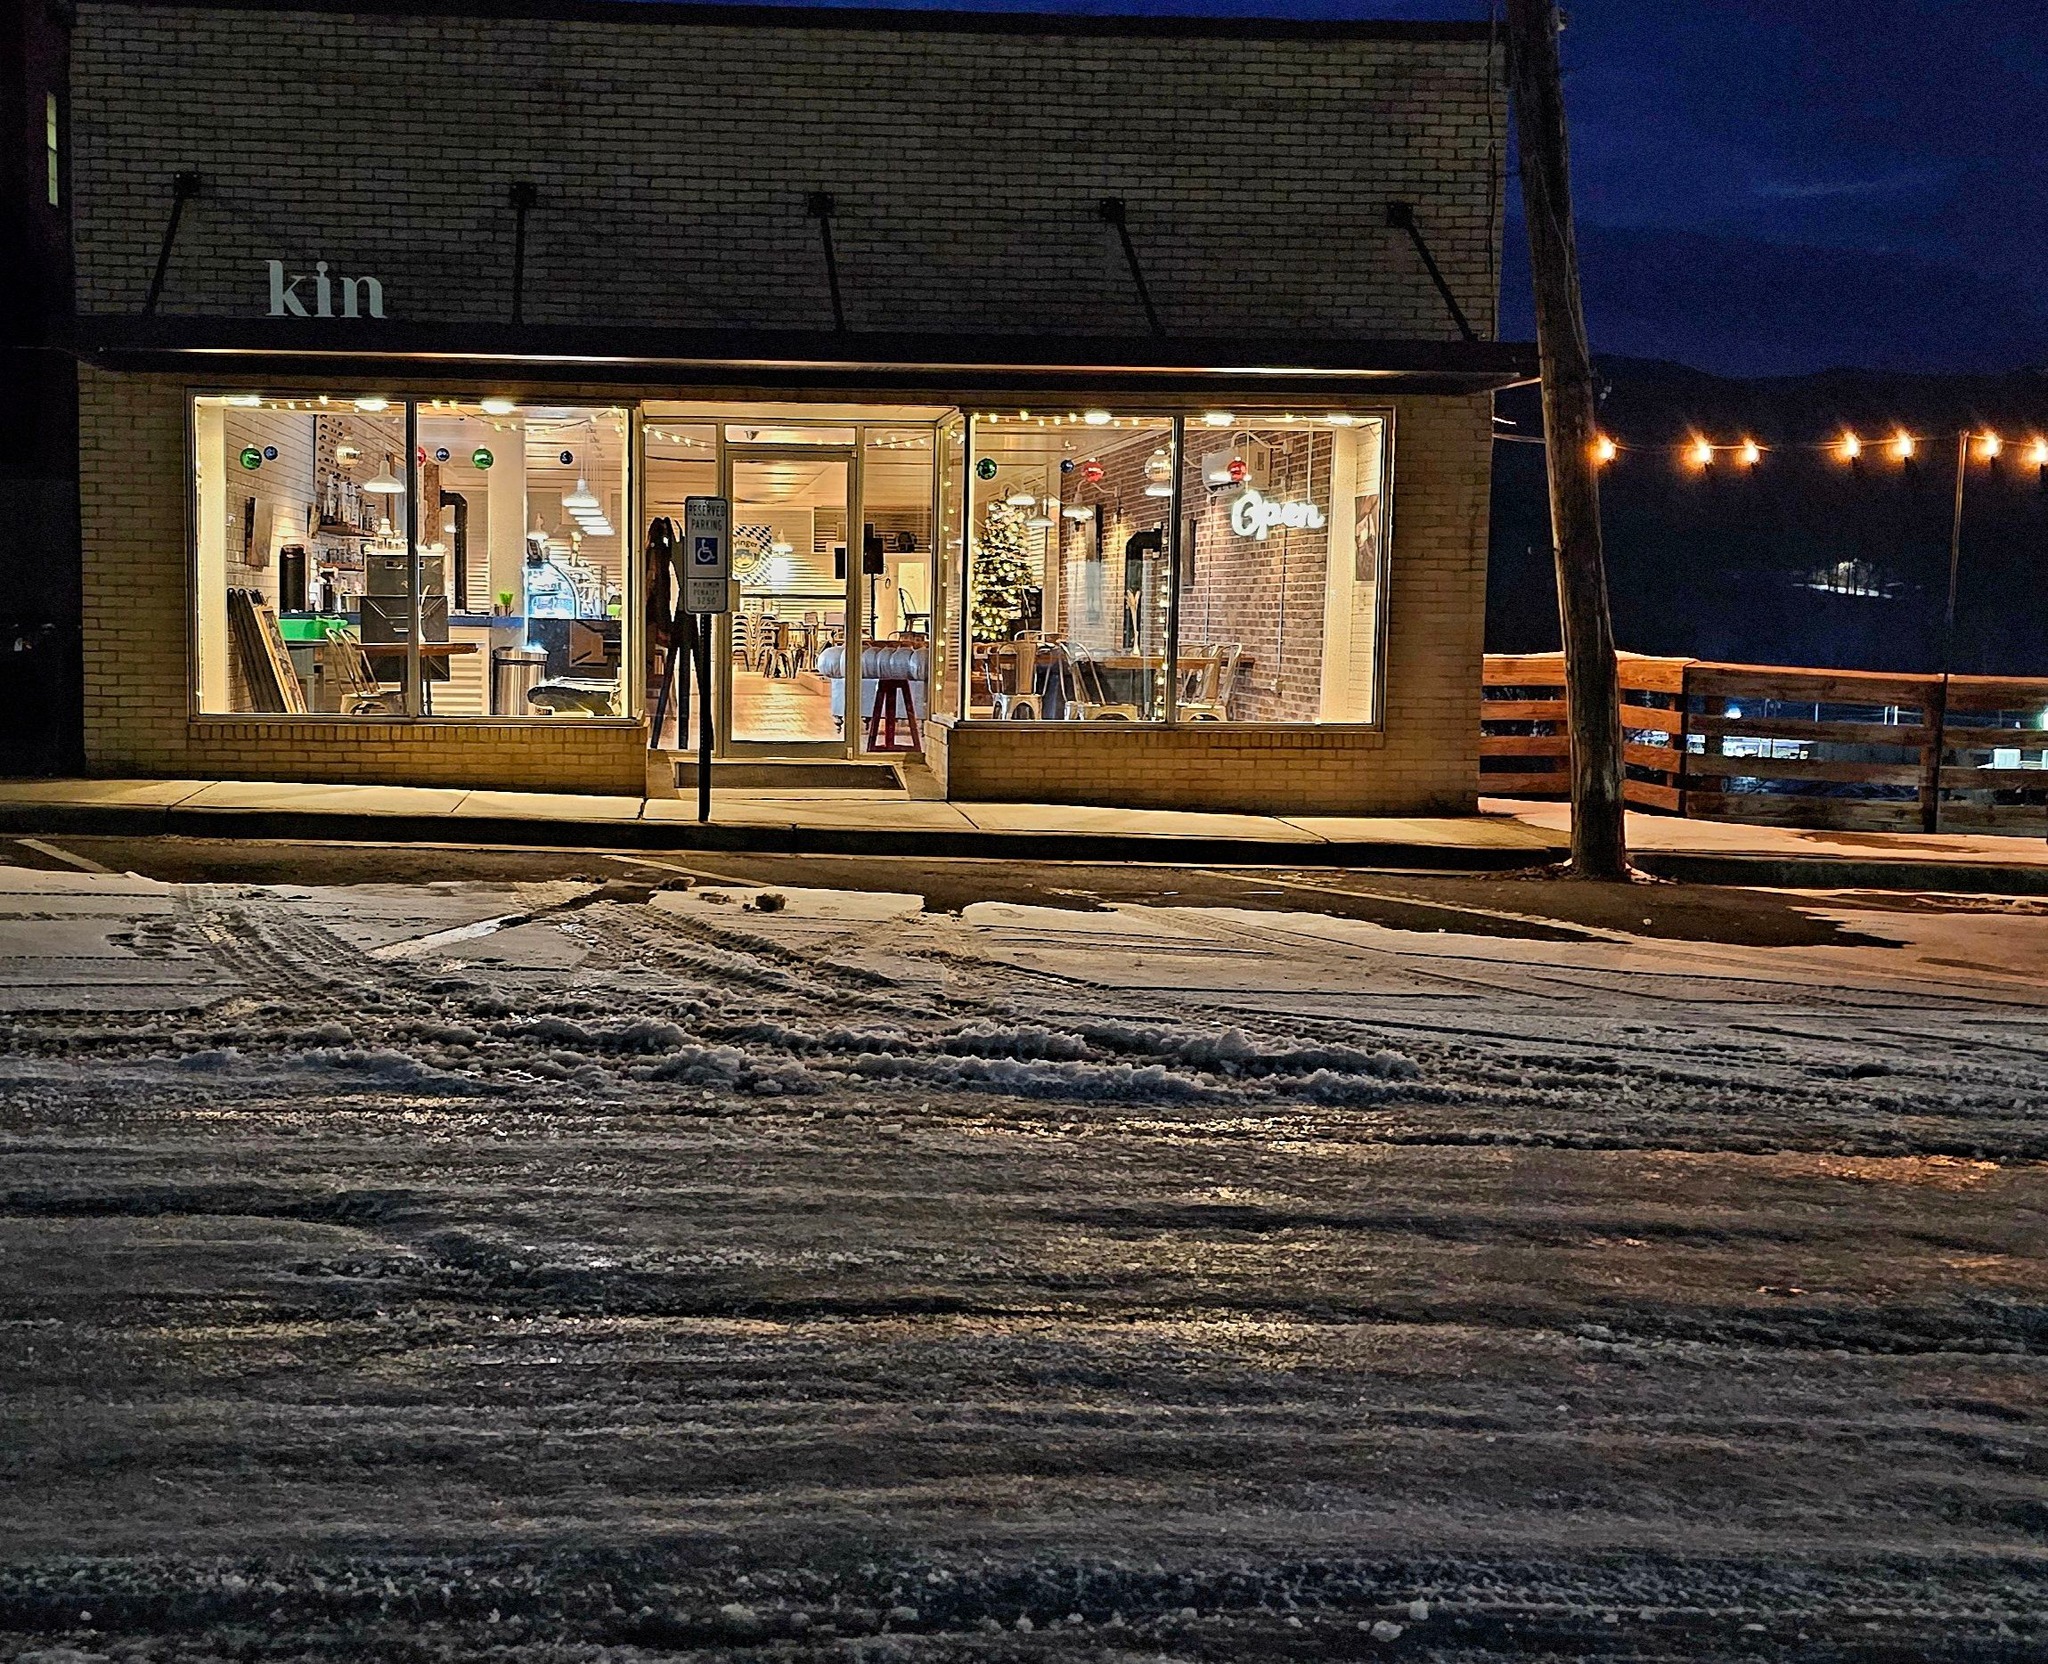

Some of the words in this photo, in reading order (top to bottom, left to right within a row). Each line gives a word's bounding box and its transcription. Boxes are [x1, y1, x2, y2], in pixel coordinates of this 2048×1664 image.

[264, 259, 388, 319] kin
[688, 504, 725, 517] RESERVED
[1231, 489, 1326, 540] Open
[691, 518, 722, 531] PARKING
[733, 540, 758, 548] yinger
